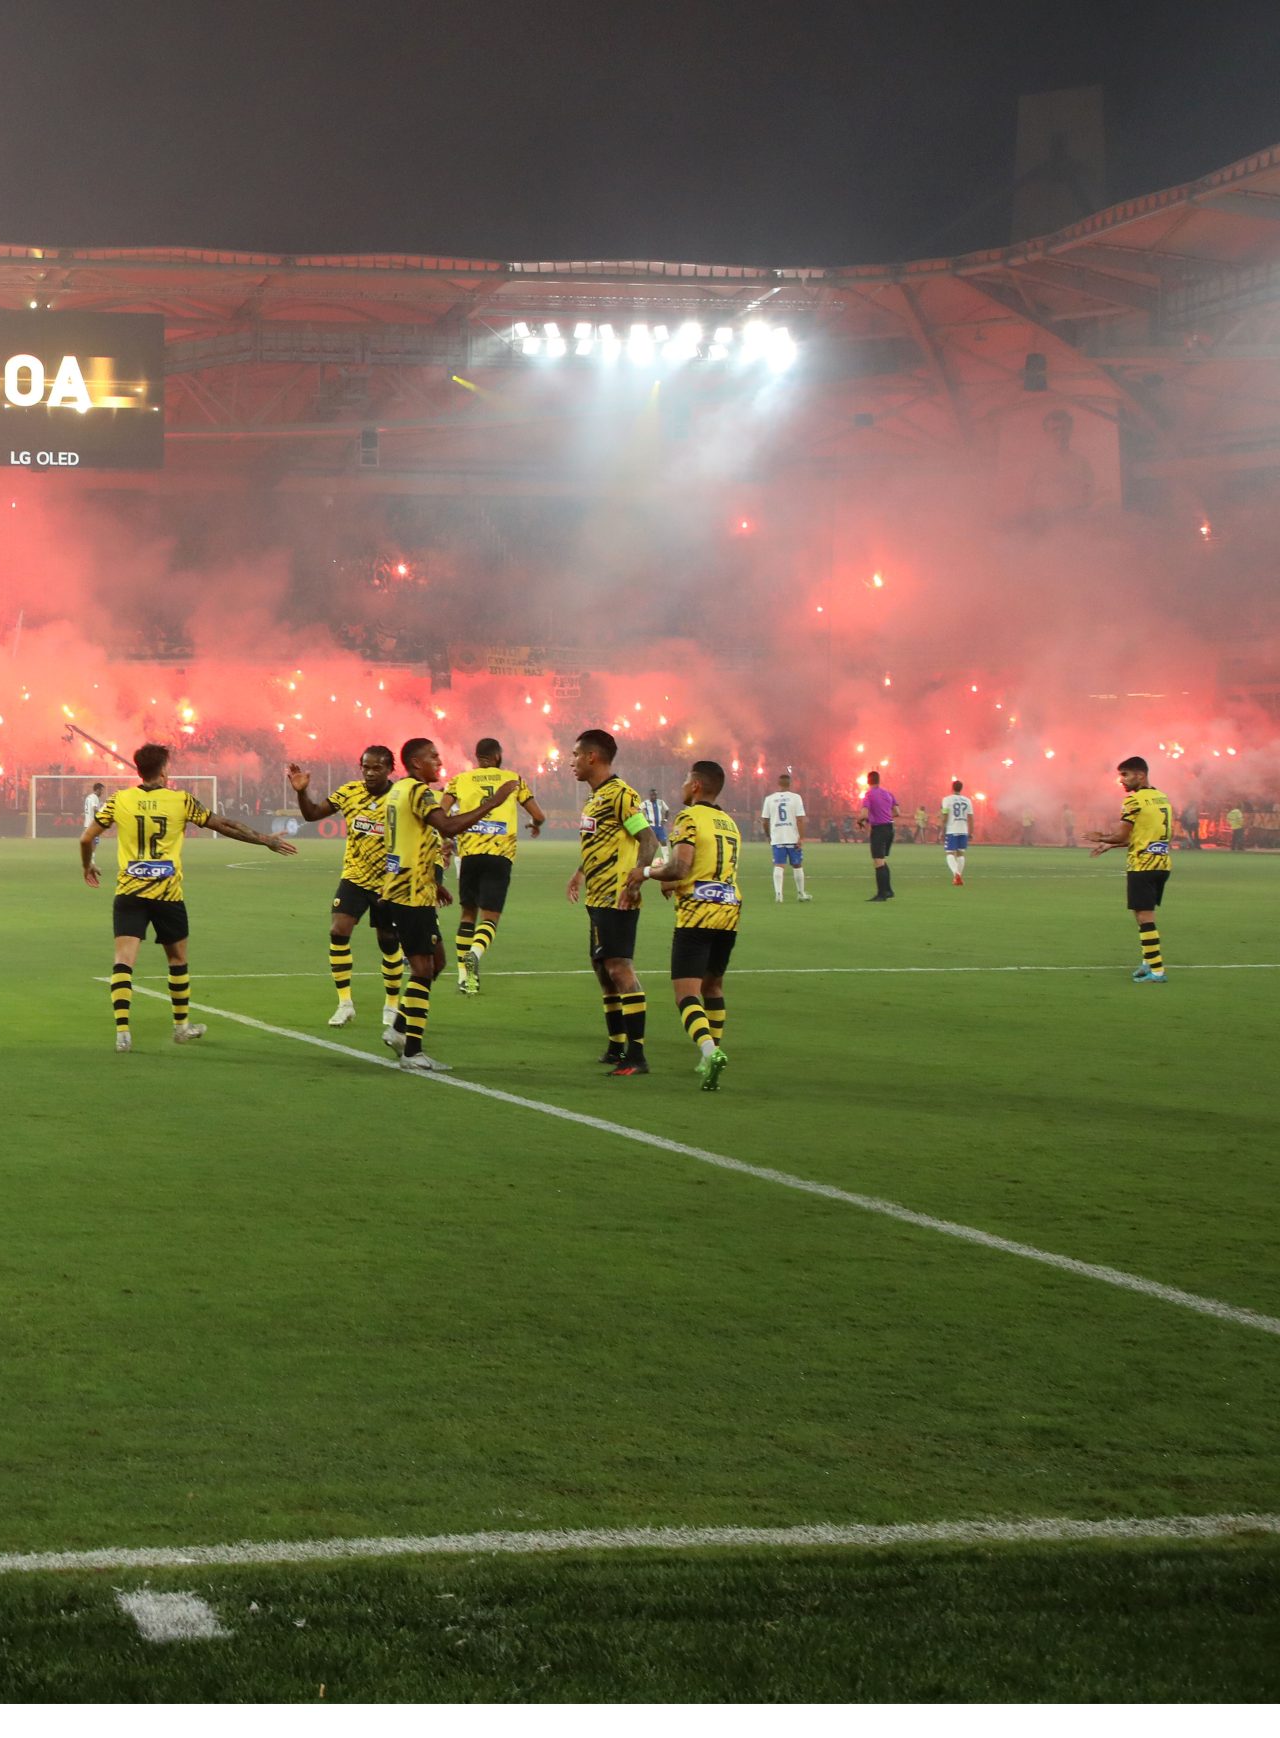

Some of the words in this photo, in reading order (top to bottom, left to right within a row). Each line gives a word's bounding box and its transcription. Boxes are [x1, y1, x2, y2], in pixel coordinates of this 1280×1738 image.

[10, 451, 31, 465] LG
[36, 451, 79, 466] OLED
[778, 802, 787, 821] 6
[953, 802, 968, 817] 87
[135, 815, 167, 860] 12
